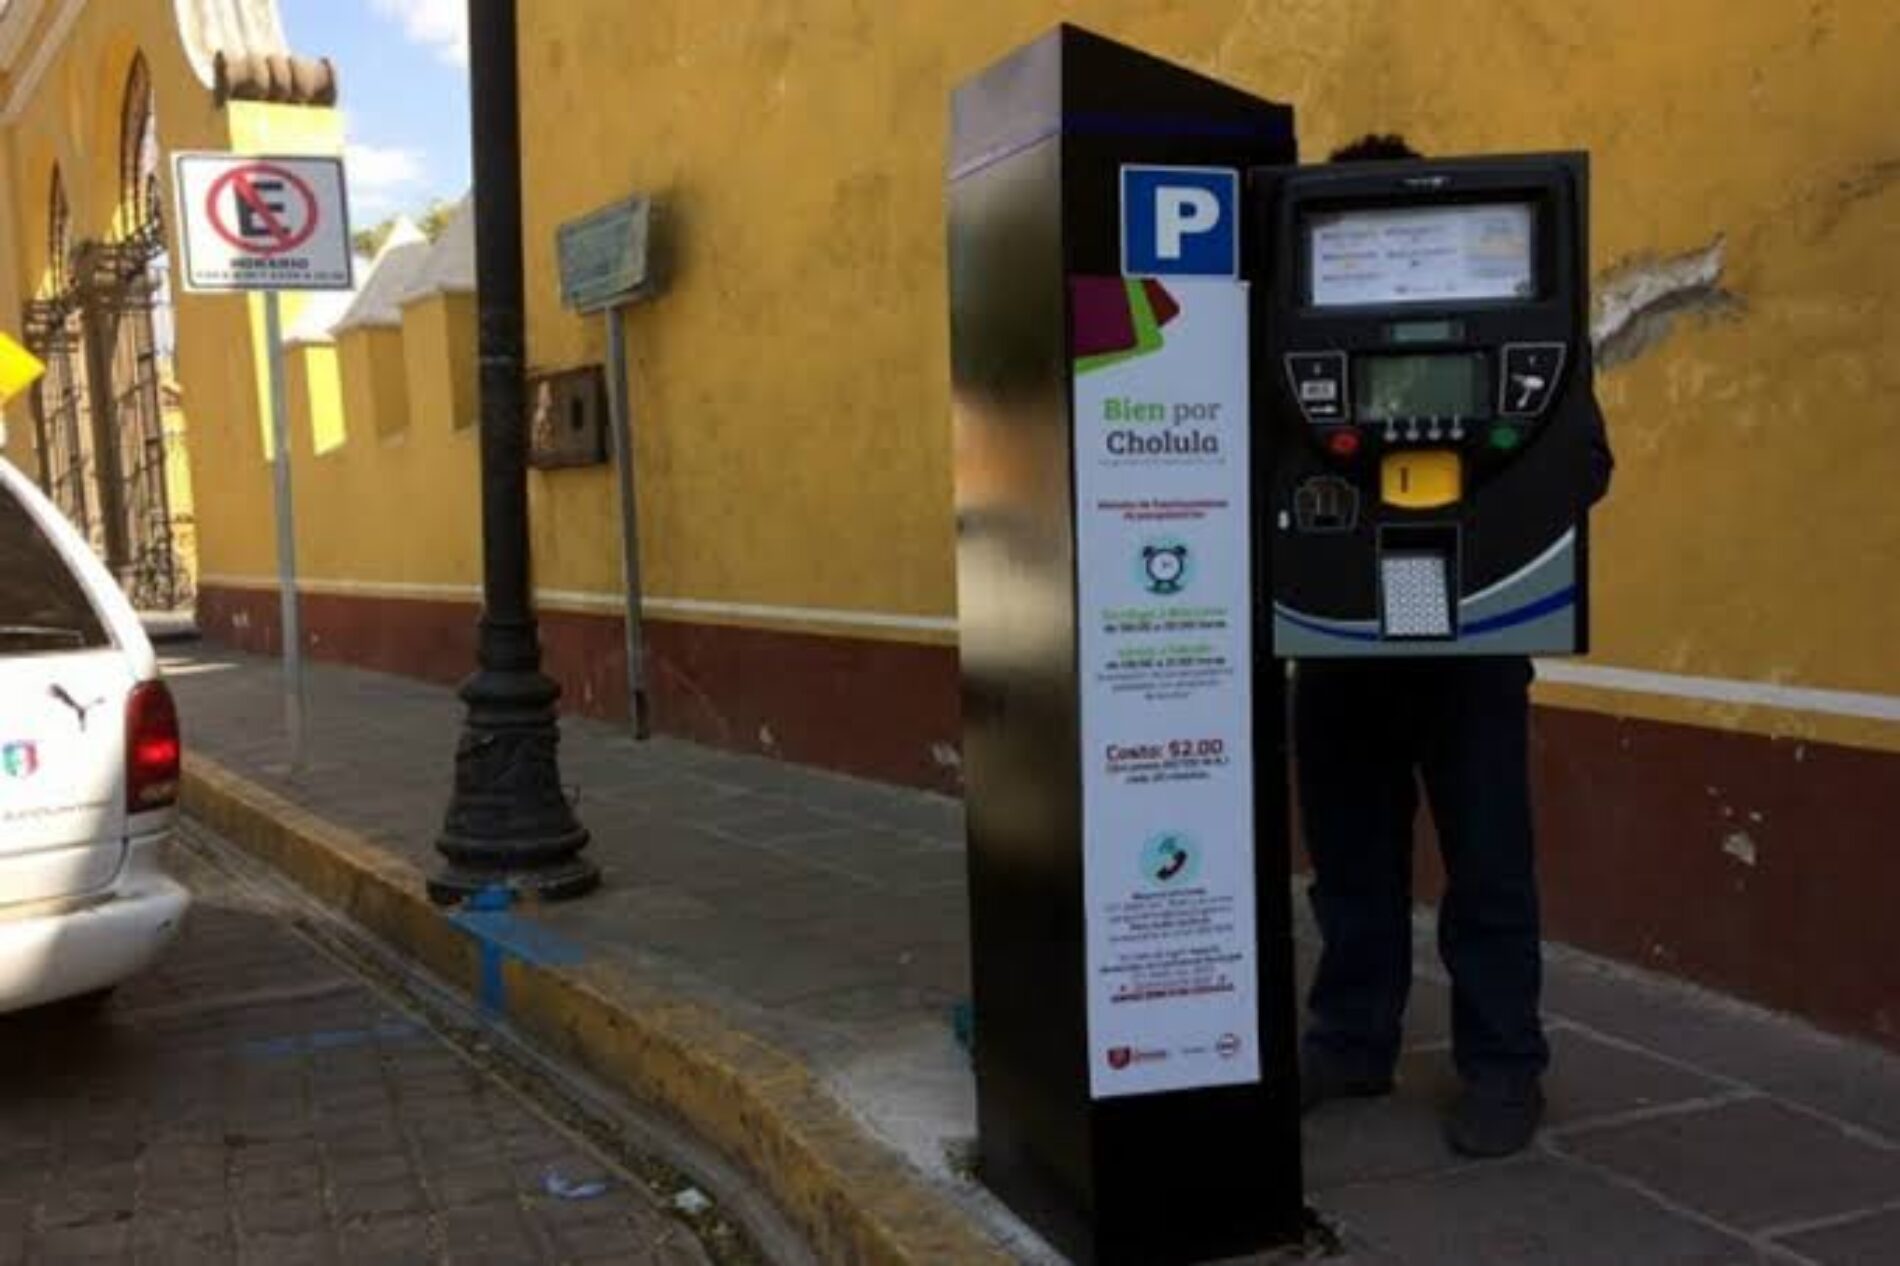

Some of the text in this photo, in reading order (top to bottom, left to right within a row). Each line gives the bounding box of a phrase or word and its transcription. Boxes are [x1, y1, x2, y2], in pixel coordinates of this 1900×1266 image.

[233, 181, 291, 237] E
[1155, 186, 1220, 260] P
[1104, 397, 1222, 427] Bien por
[1106, 429, 1219, 455] Cholula
[1106, 743, 1162, 762] Costo:
